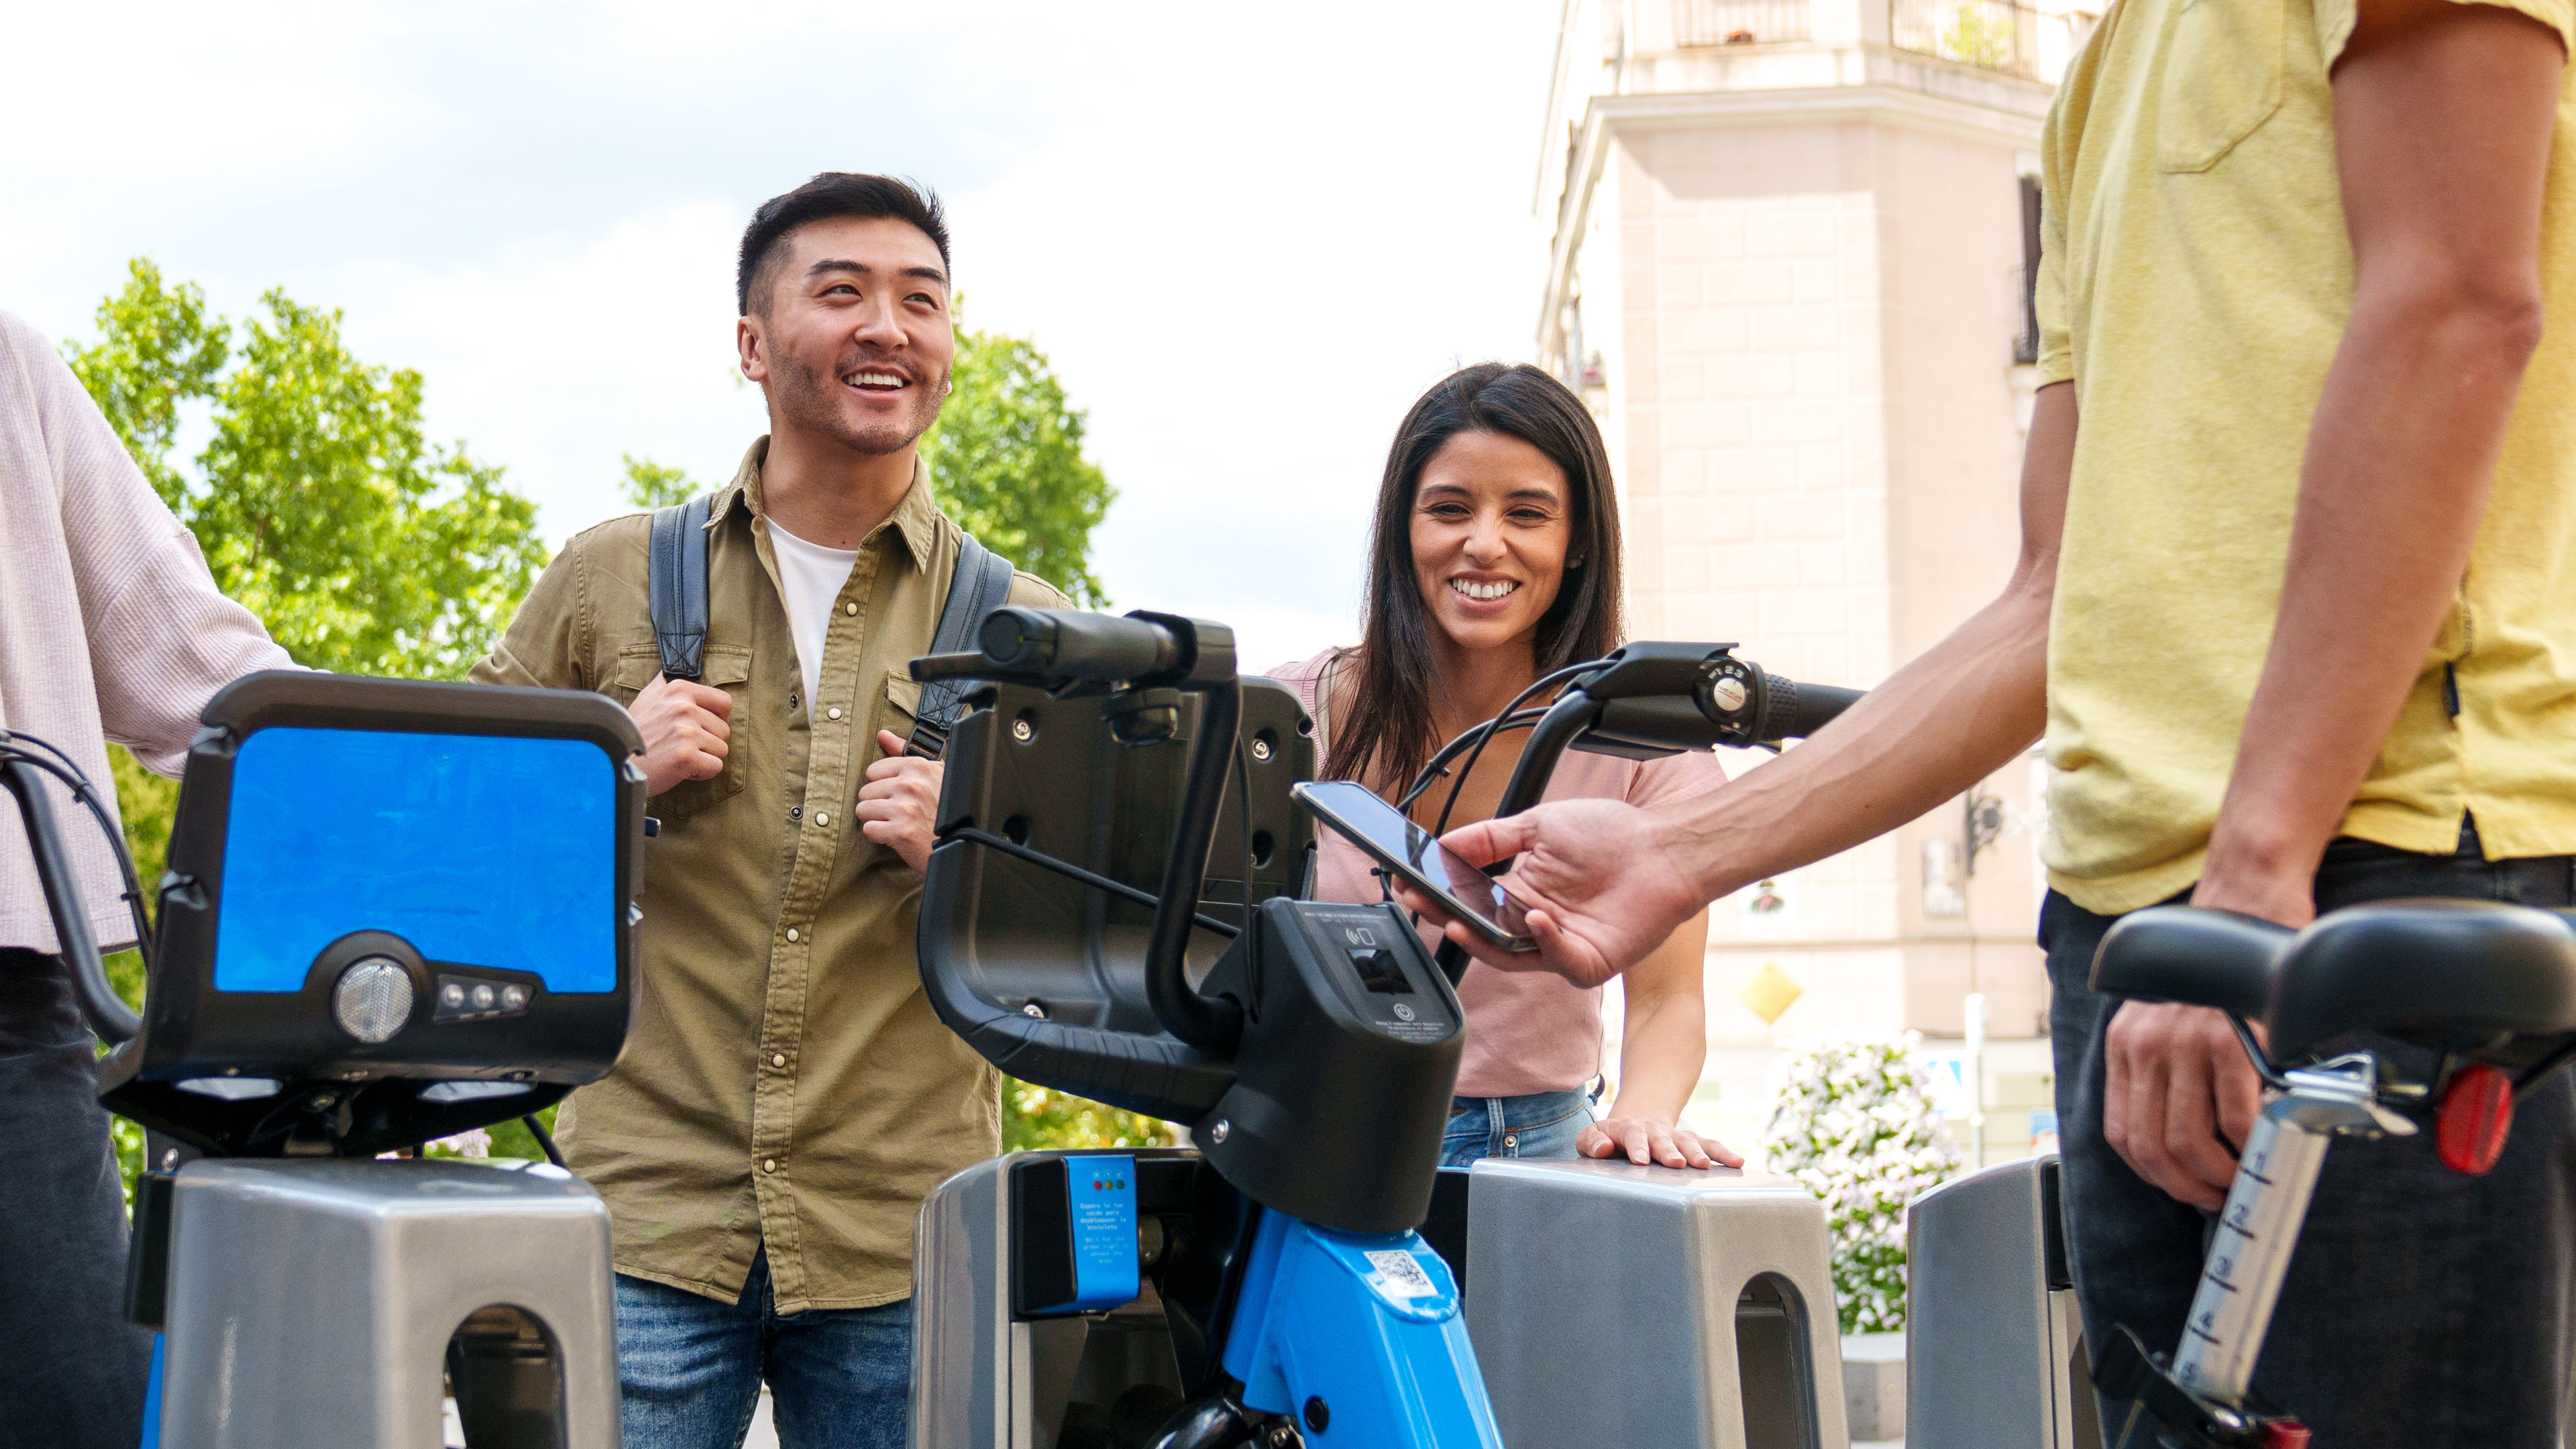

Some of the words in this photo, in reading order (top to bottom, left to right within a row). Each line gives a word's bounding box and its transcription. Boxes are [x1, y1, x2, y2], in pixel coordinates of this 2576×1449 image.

[1715, 667, 1723, 676] 1
[1724, 665, 1734, 675] 2
[1734, 668, 1744, 679] 3
[2256, 1152, 2266, 1171] 1
[2232, 1204, 2250, 1224] 2
[2214, 1255, 2233, 1276] 3
[2200, 1311, 2214, 1328] 4
